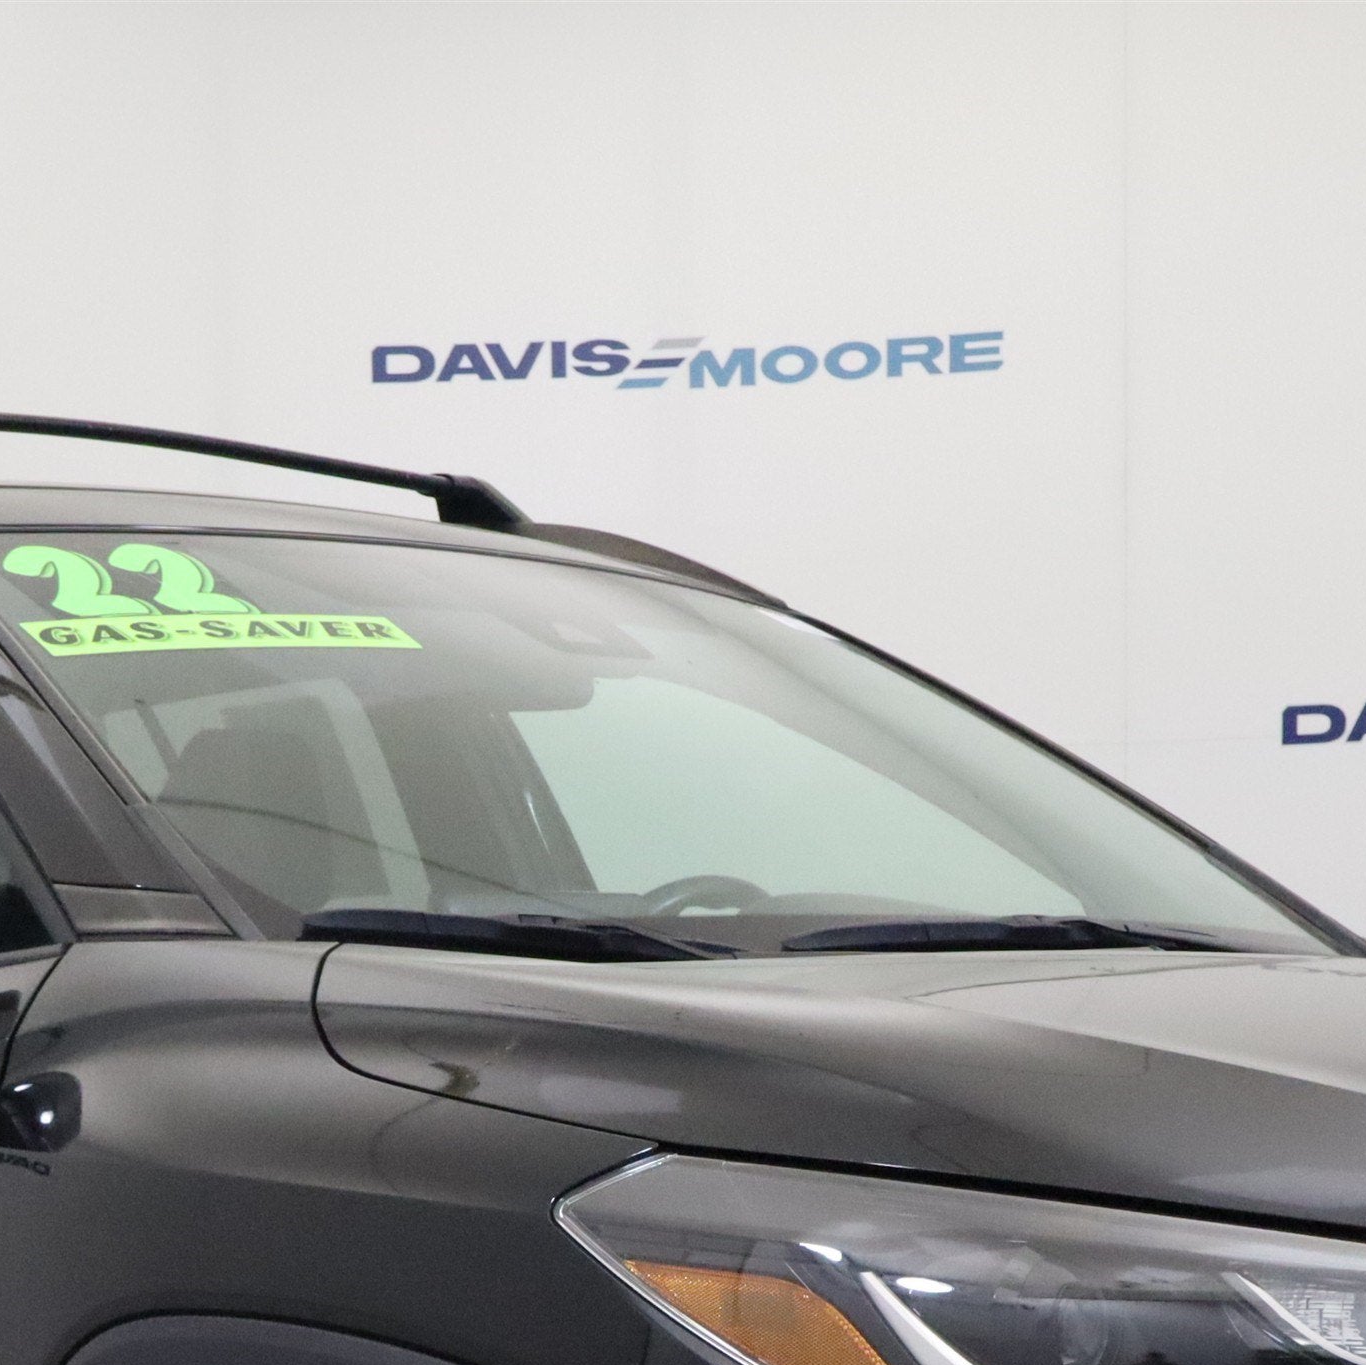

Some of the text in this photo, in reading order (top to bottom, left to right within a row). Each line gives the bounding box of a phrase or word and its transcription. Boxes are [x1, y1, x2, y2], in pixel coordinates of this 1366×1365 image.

[372, 330, 1005, 389] DAVIS MOORE
[2, 543, 261, 617] 22
[38, 619, 398, 646] GAS-SAVER
